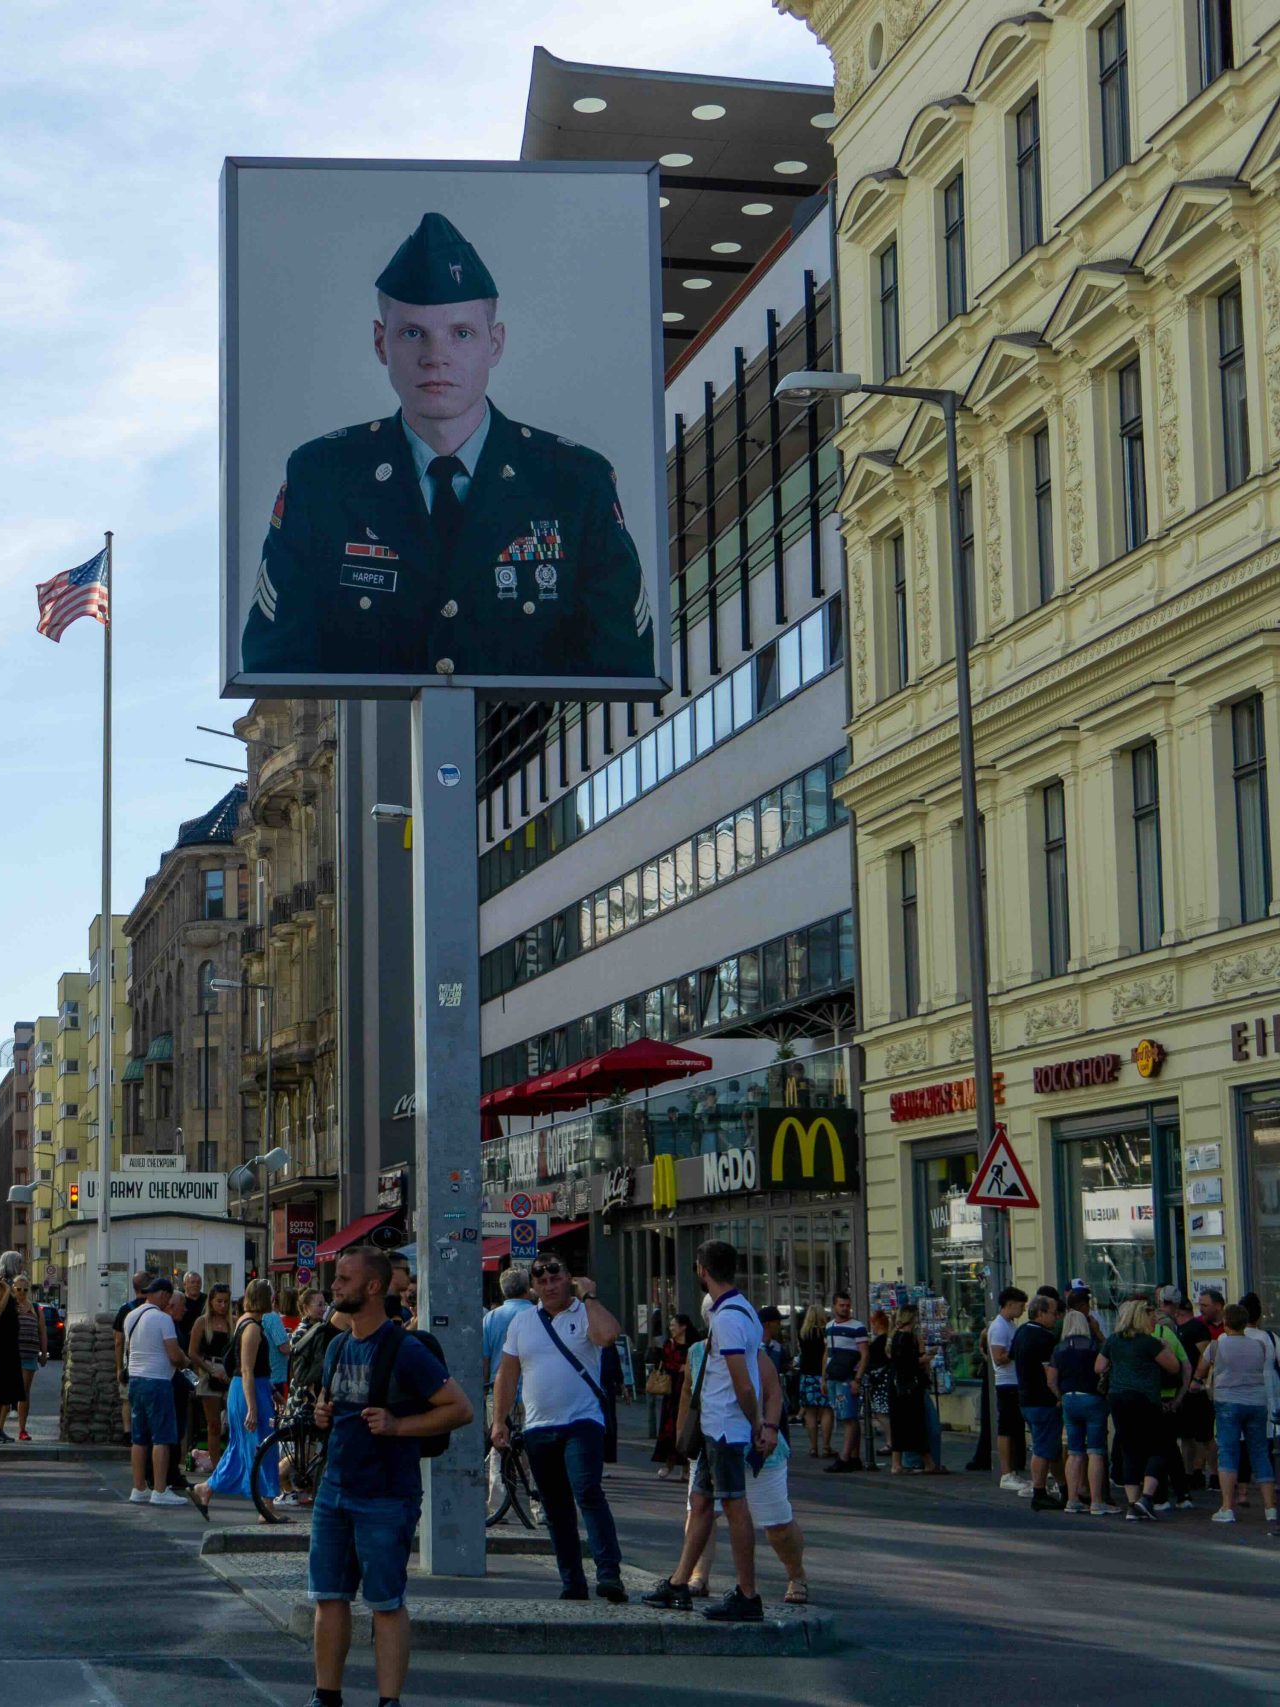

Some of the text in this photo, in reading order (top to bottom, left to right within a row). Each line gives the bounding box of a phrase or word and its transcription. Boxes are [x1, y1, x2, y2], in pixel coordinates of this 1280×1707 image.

[351, 570, 385, 585] HARPER
[1033, 1062, 1071, 1093] ROCK
[963, 1072, 1006, 1111] ME
[129, 1157, 177, 1168] ALLIED CHECKPOINT
[110, 1181, 144, 1199] ARMY
[148, 1181, 220, 1200] CHECKPOINT
[289, 1220, 314, 1228] SOTTO
[481, 1220, 507, 1229] disches
[512, 1245, 536, 1256] TAXI
